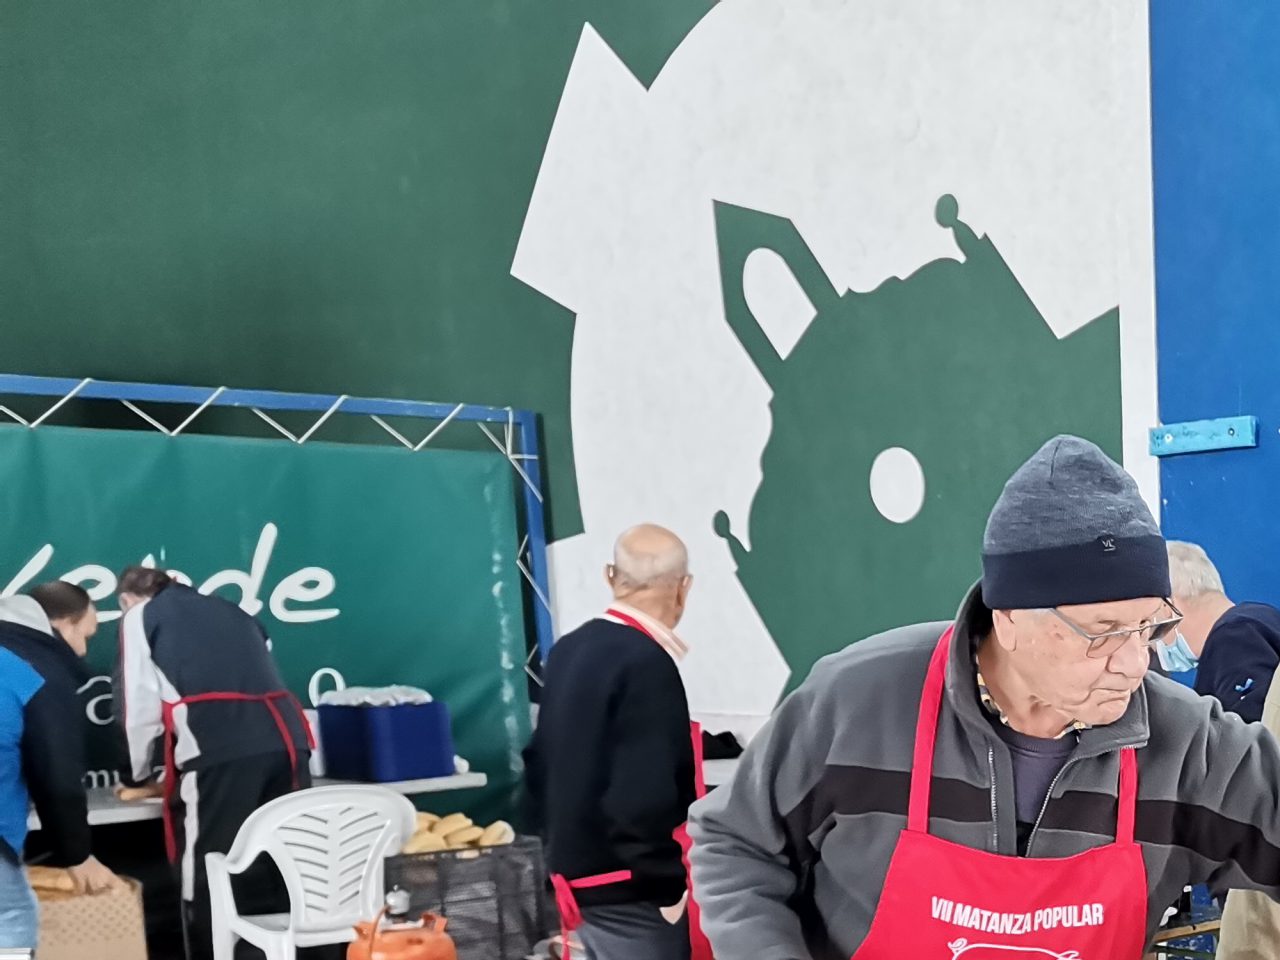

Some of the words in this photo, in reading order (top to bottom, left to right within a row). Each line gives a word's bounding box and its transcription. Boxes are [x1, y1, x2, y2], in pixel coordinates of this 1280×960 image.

[931, 896, 954, 923] VII
[953, 903, 1032, 935] MATANZA
[1033, 903, 1104, 931] POPULAR
